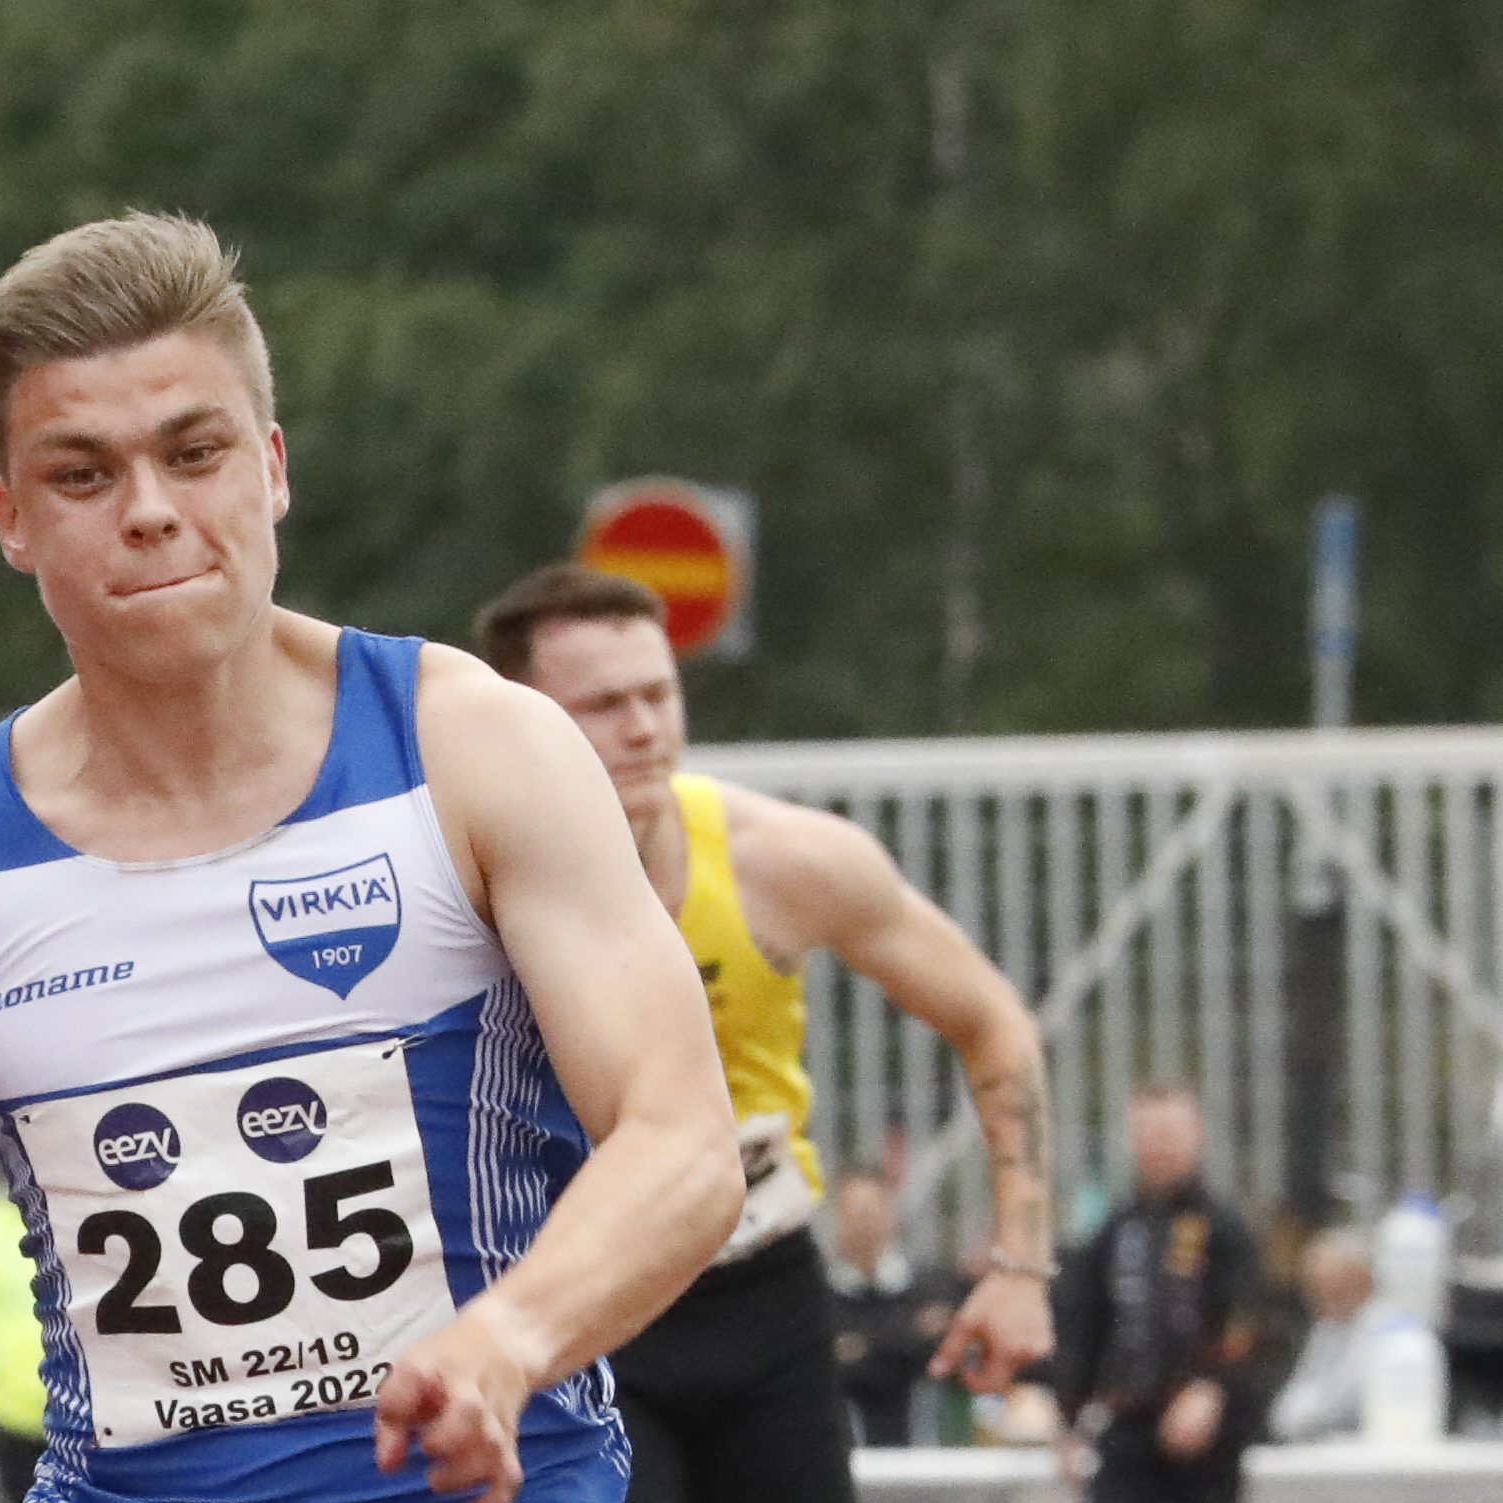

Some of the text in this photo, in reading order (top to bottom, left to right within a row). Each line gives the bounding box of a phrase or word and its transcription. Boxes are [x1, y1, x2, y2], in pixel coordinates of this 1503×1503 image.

[259, 876, 394, 923] VIRKIÄ
[311, 943, 364, 970] 1907
[241, 1100, 327, 1139] eezy
[98, 1130, 181, 1167] eezy
[77, 1160, 414, 1335] 285
[168, 1331, 360, 1388] SM 22/19
[155, 1393, 277, 1430] Vaasa
